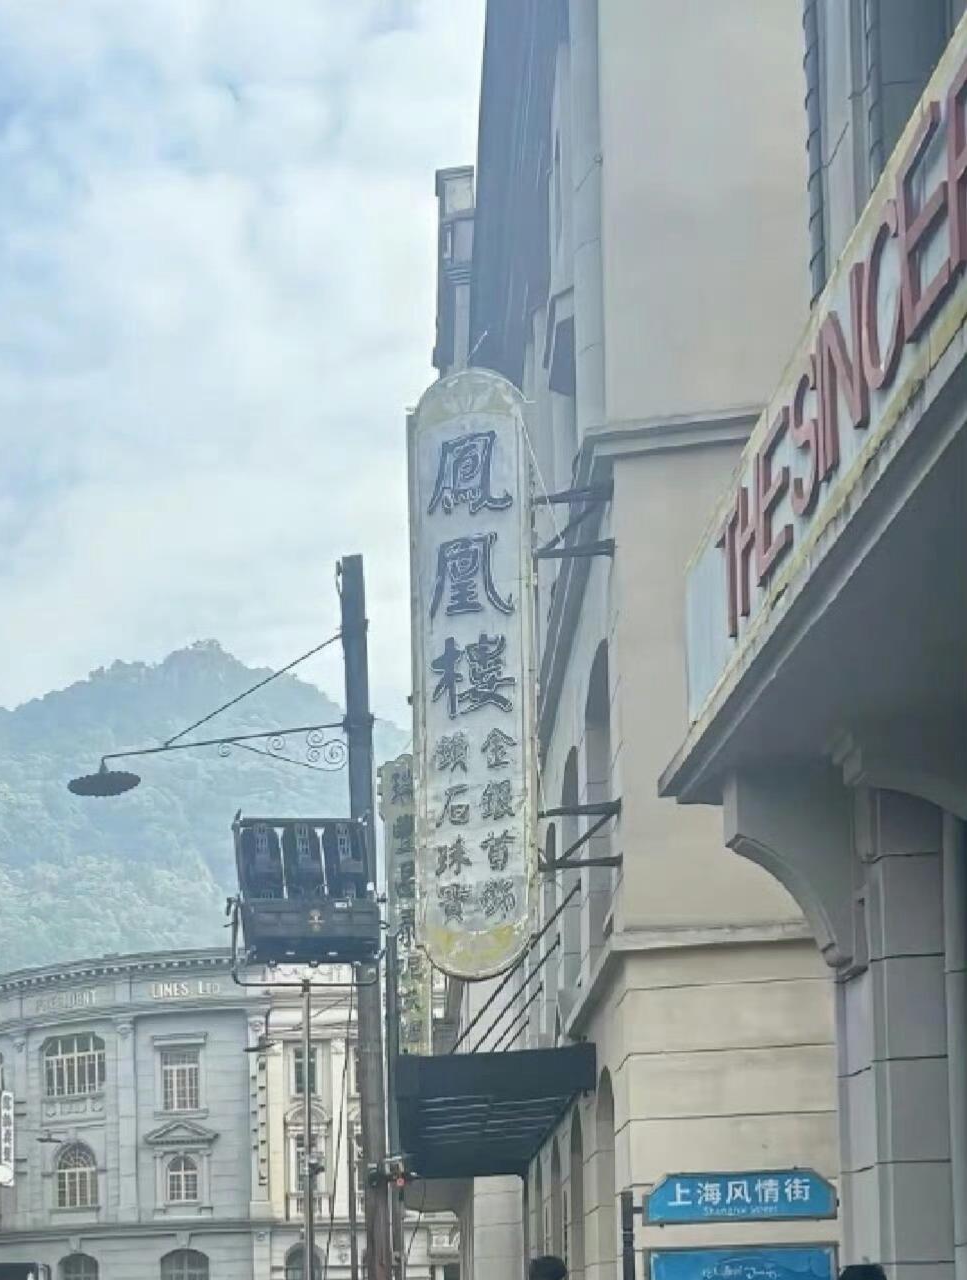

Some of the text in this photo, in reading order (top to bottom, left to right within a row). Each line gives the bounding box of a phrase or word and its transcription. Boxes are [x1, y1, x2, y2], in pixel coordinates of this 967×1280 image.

[716, 406, 794, 638] THE
[668, 1178, 810, 1206] 上海风情街
